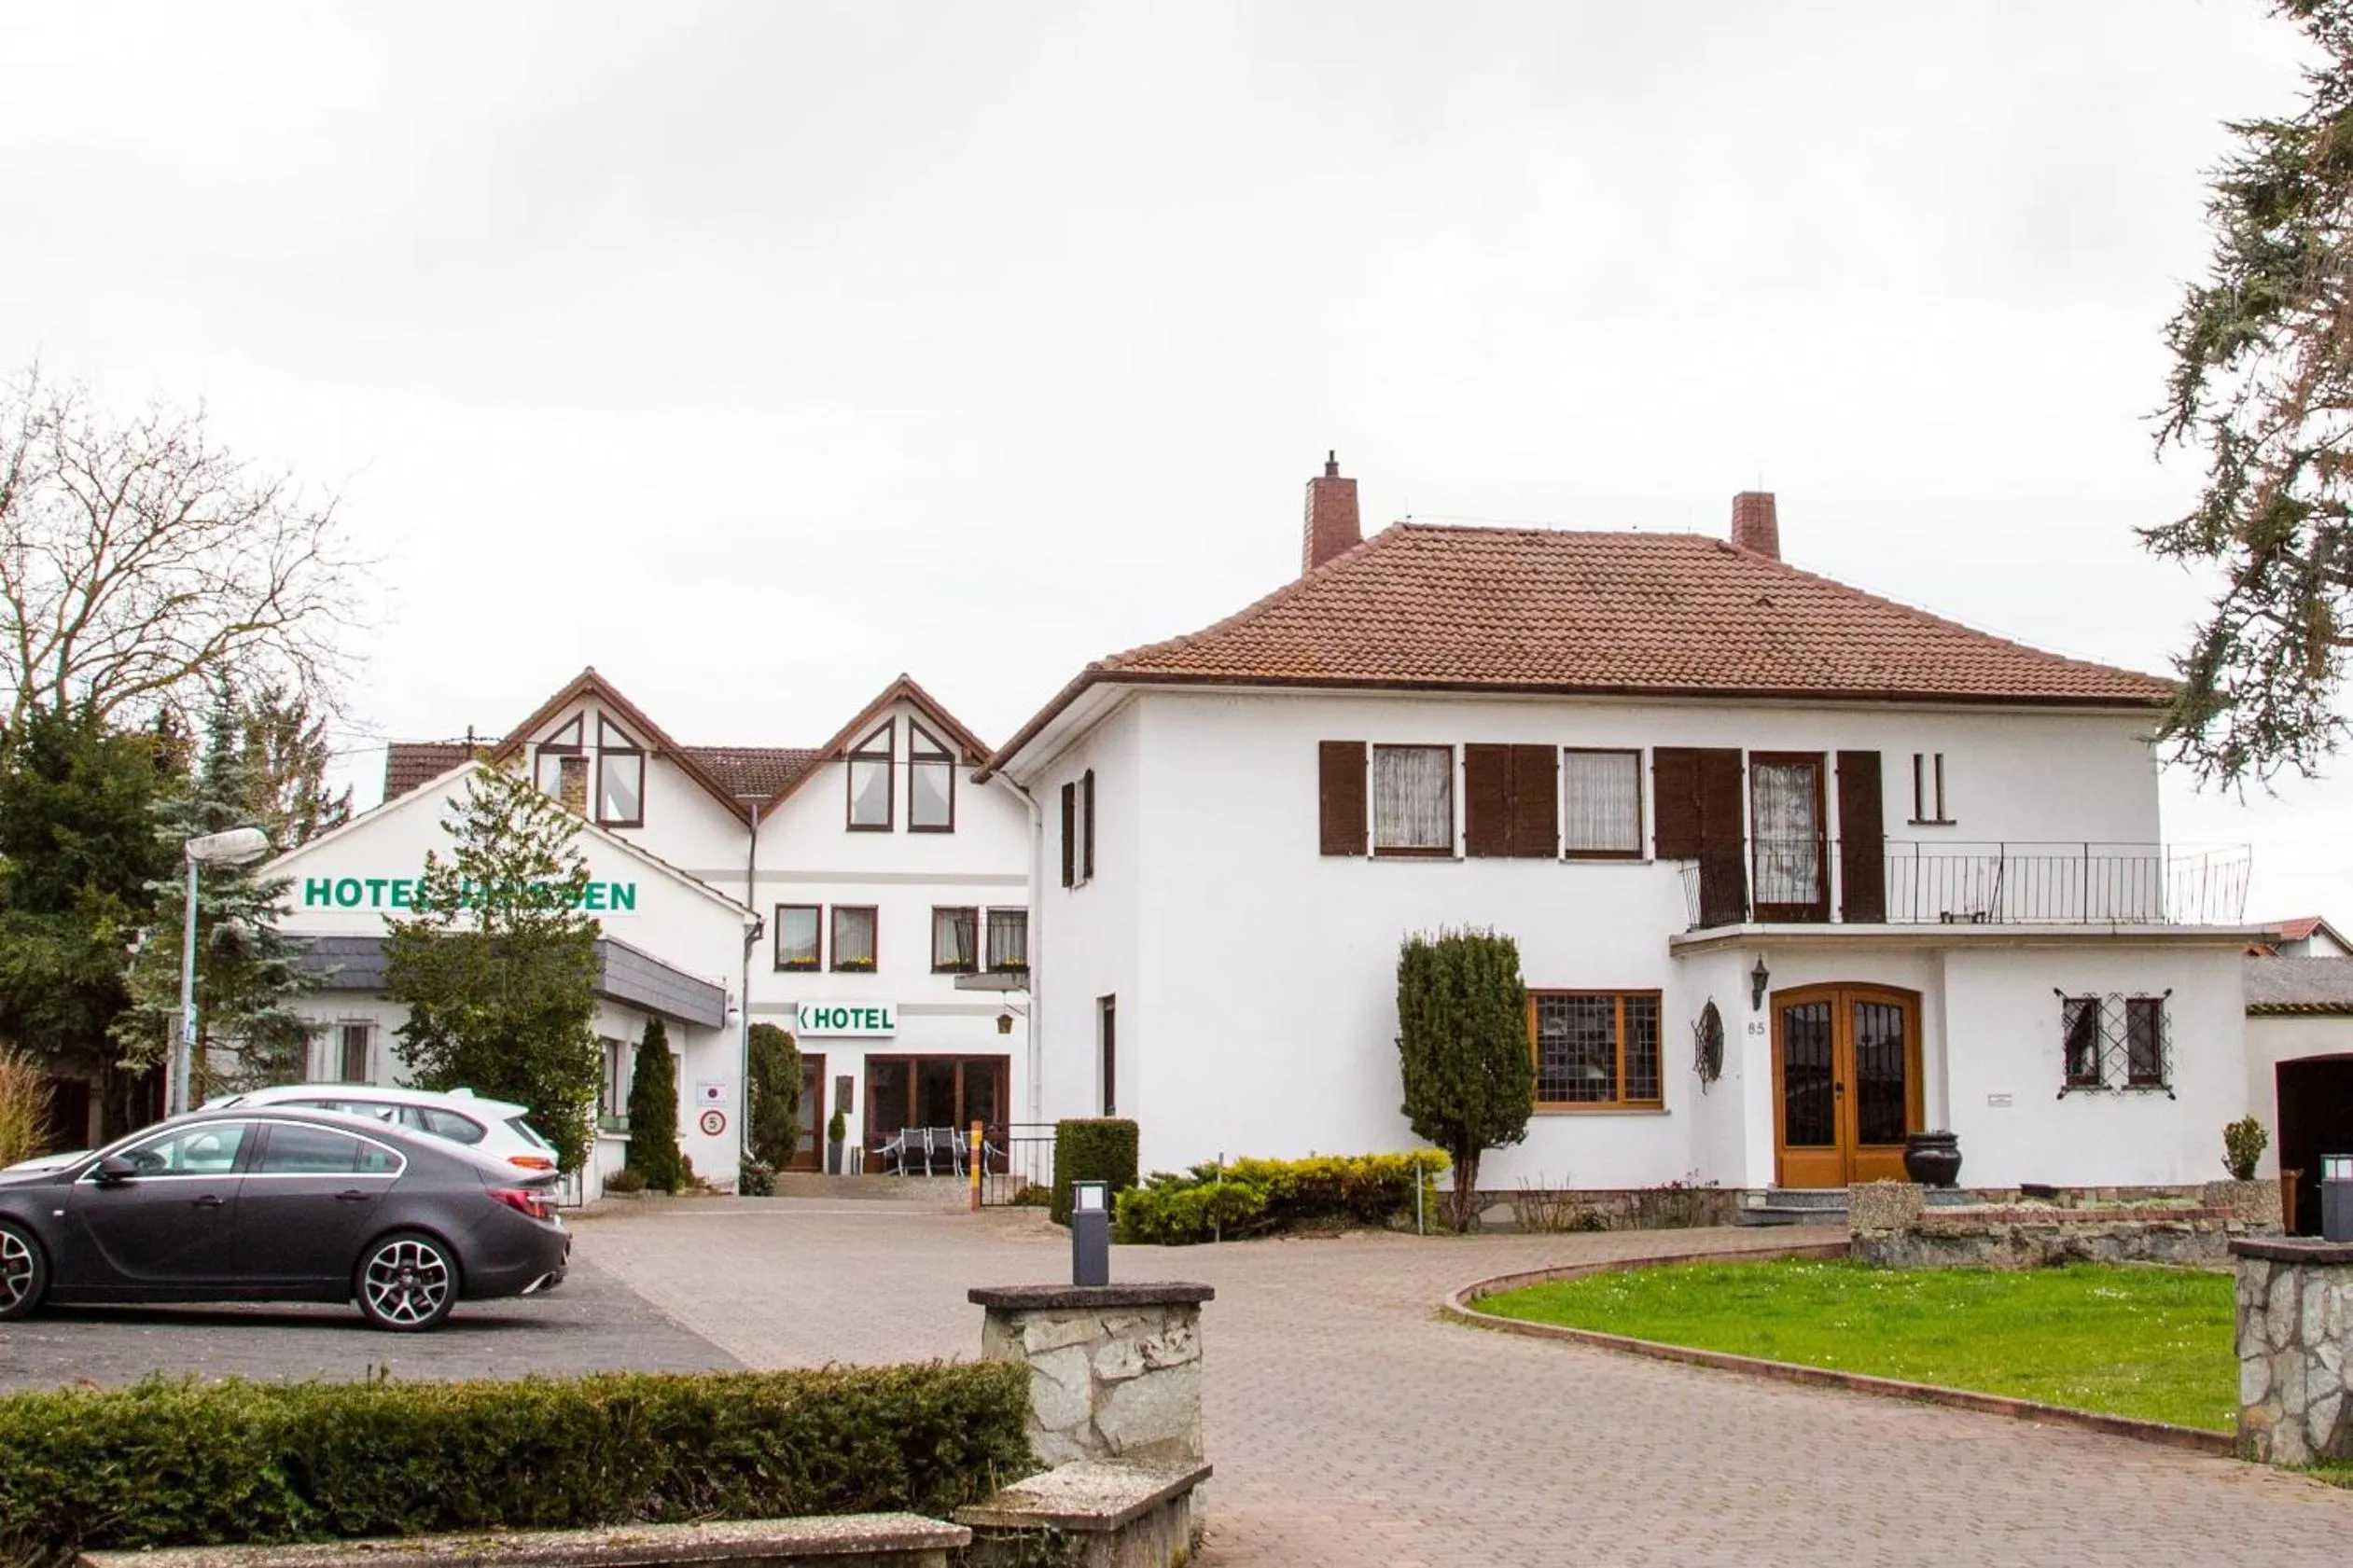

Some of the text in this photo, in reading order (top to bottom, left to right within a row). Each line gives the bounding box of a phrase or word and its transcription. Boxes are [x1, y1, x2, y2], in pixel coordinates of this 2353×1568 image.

[814, 1007, 895, 1029] HOTEL
[1748, 1021, 1765, 1035] 85
[709, 1117, 717, 1130] 5
